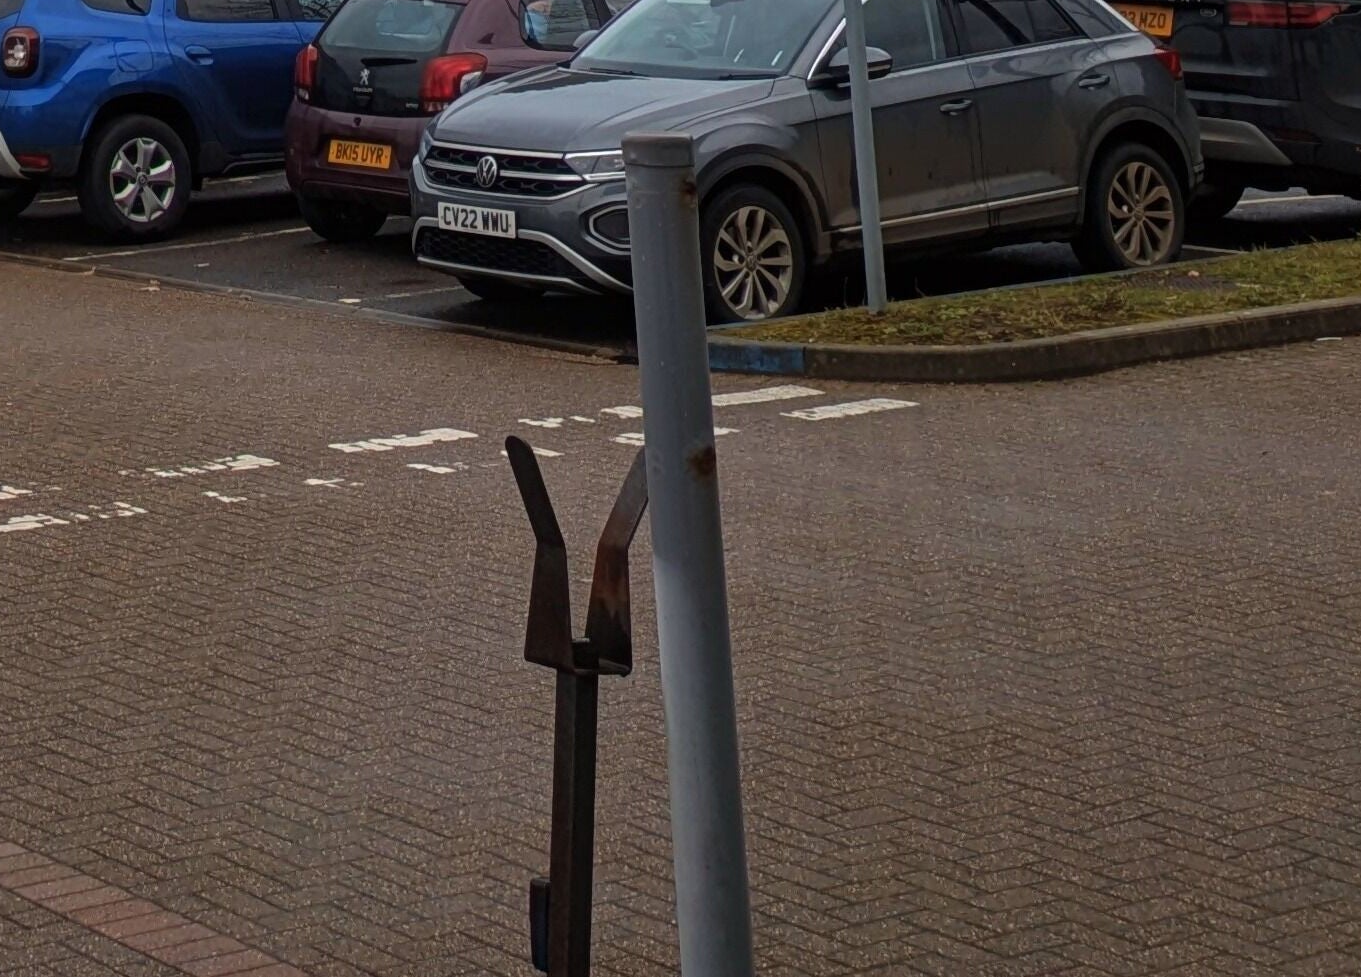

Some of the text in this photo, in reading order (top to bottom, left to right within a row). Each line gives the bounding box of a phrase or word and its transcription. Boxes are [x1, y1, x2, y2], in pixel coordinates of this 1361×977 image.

[335, 143, 384, 164] BK15 UYR
[443, 206, 509, 233] CV22 WWU
